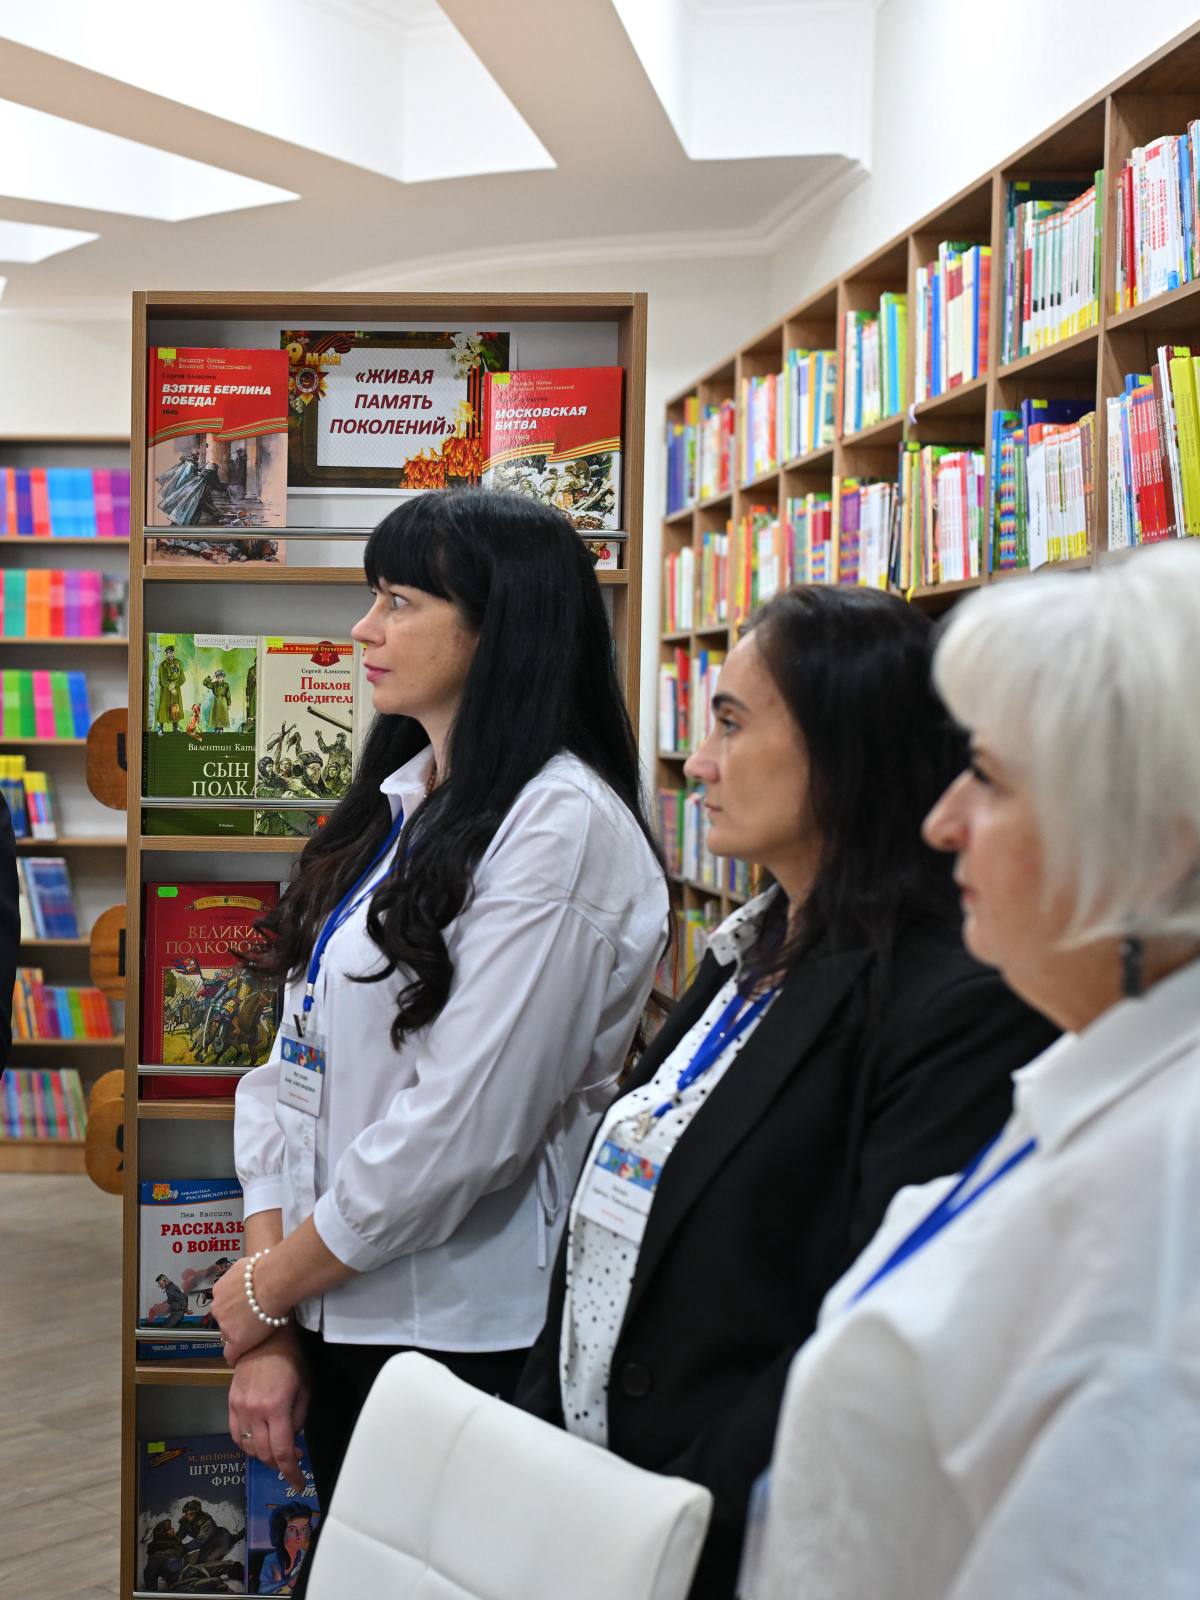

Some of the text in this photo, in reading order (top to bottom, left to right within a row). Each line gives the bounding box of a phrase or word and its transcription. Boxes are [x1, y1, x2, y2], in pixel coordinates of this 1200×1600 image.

[286, 342, 341, 365] 9 МАЯ
[355, 369, 434, 384] «ЖИВАЯ
[162, 384, 271, 395] ВЗЯТИЕ БЕРЛИНА
[161, 396, 216, 407] ПОБЕДА!
[354, 394, 433, 409] ПАМЯТЬ
[495, 406, 587, 418] МОСКОВСКАЯ
[329, 416, 456, 434] ПОКОЛЕНИЙ»
[495, 420, 537, 430] БИТВА
[301, 676, 350, 690] Поклон
[188, 744, 232, 752] Валентин
[203, 762, 250, 778] СЫН
[172, 1237, 240, 1254] О ВОЙНЕ
